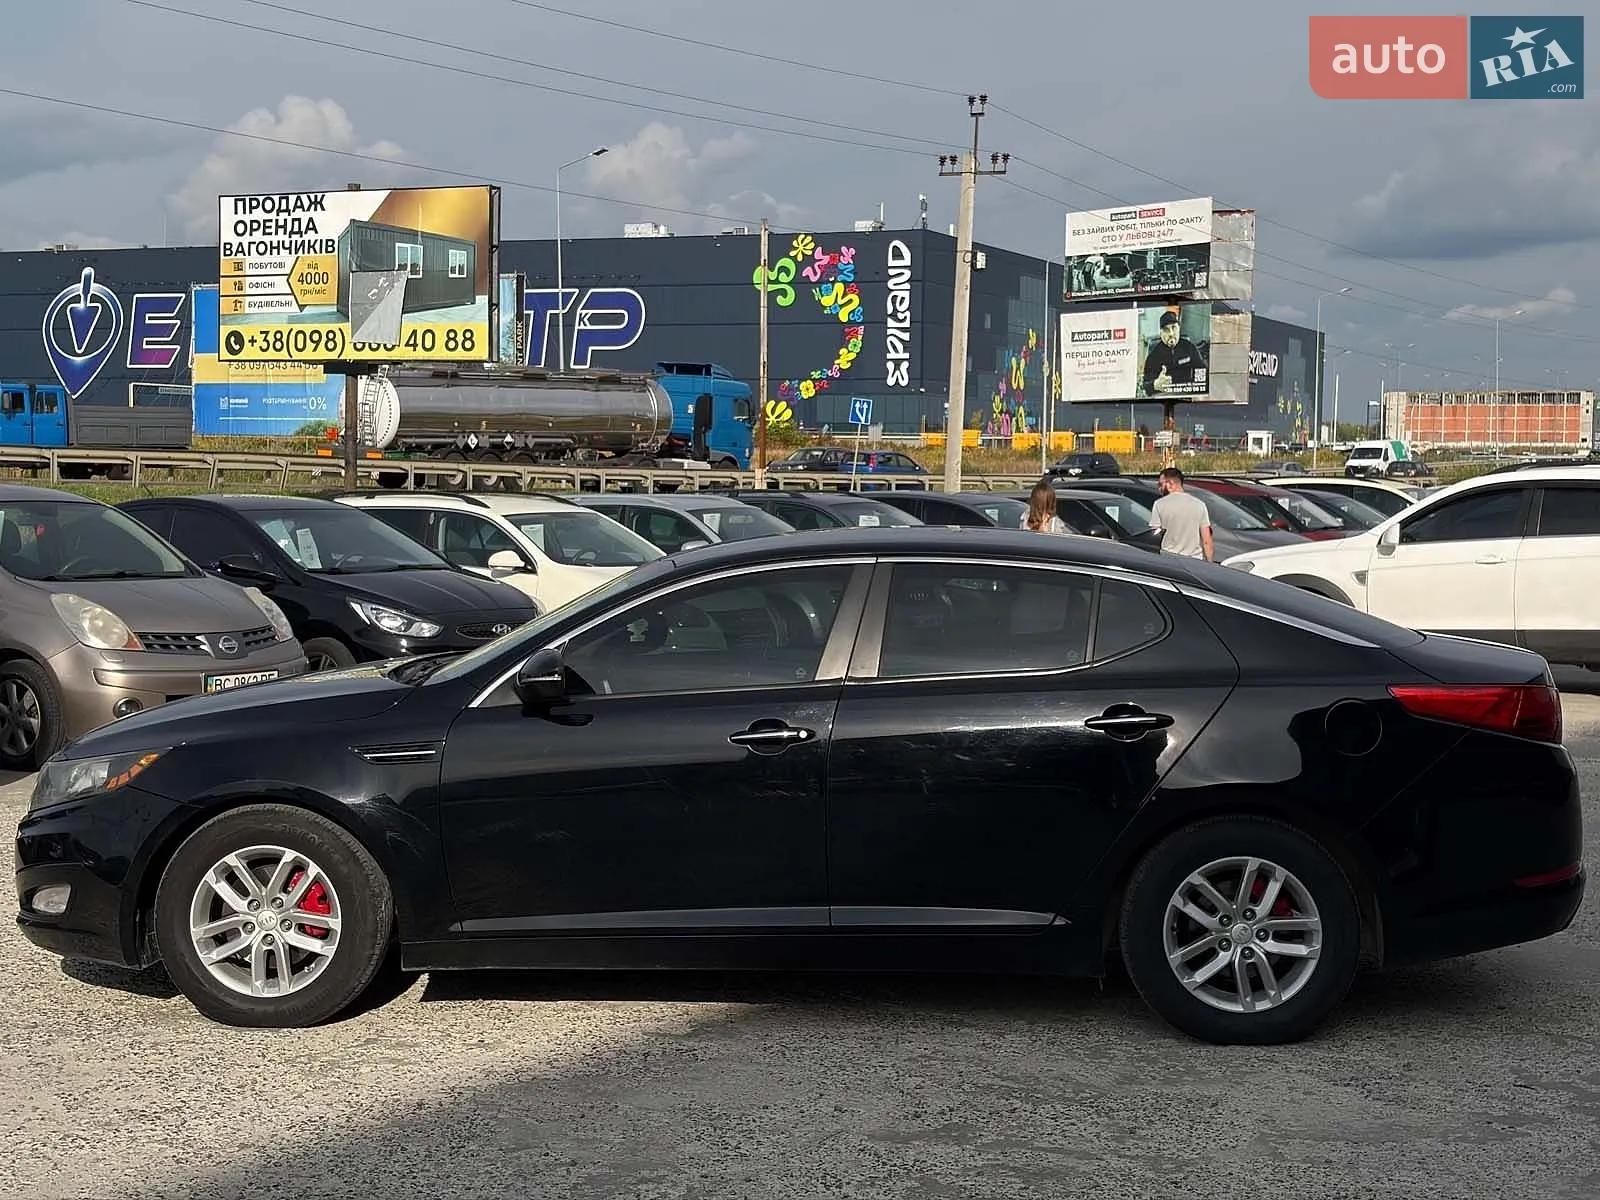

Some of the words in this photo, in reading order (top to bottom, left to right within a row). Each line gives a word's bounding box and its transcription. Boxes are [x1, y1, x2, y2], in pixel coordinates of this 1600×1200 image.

[234, 194, 326, 216] ПРОДАЖ
[233, 217, 319, 239] ОРЕНДА
[1086, 225, 1115, 235] ЗАЙВИХ
[1101, 235, 1117, 243] СТО
[1157, 229, 1174, 239] 24/7
[223, 239, 336, 257] ВАГОНЧИКІВ
[248, 261, 286, 270] ПОБУТОВІ
[307, 261, 319, 271] від
[297, 271, 329, 285] 4000
[248, 281, 276, 289] ОФІСНІ
[299, 287, 327, 297] грн/міс
[247, 299, 293, 309] БУДІВЕЛЬНІ
[516, 320, 524, 349] PARK
[1073, 330, 1109, 342] Autopark
[247, 327, 346, 359] +38(098)
[404, 328, 437, 353] 40
[444, 328, 476, 353] 88
[1065, 350, 1090, 359] ПЕРШІ
[1091, 350, 1103, 358] ПО
[308, 396, 328, 411] 0%
